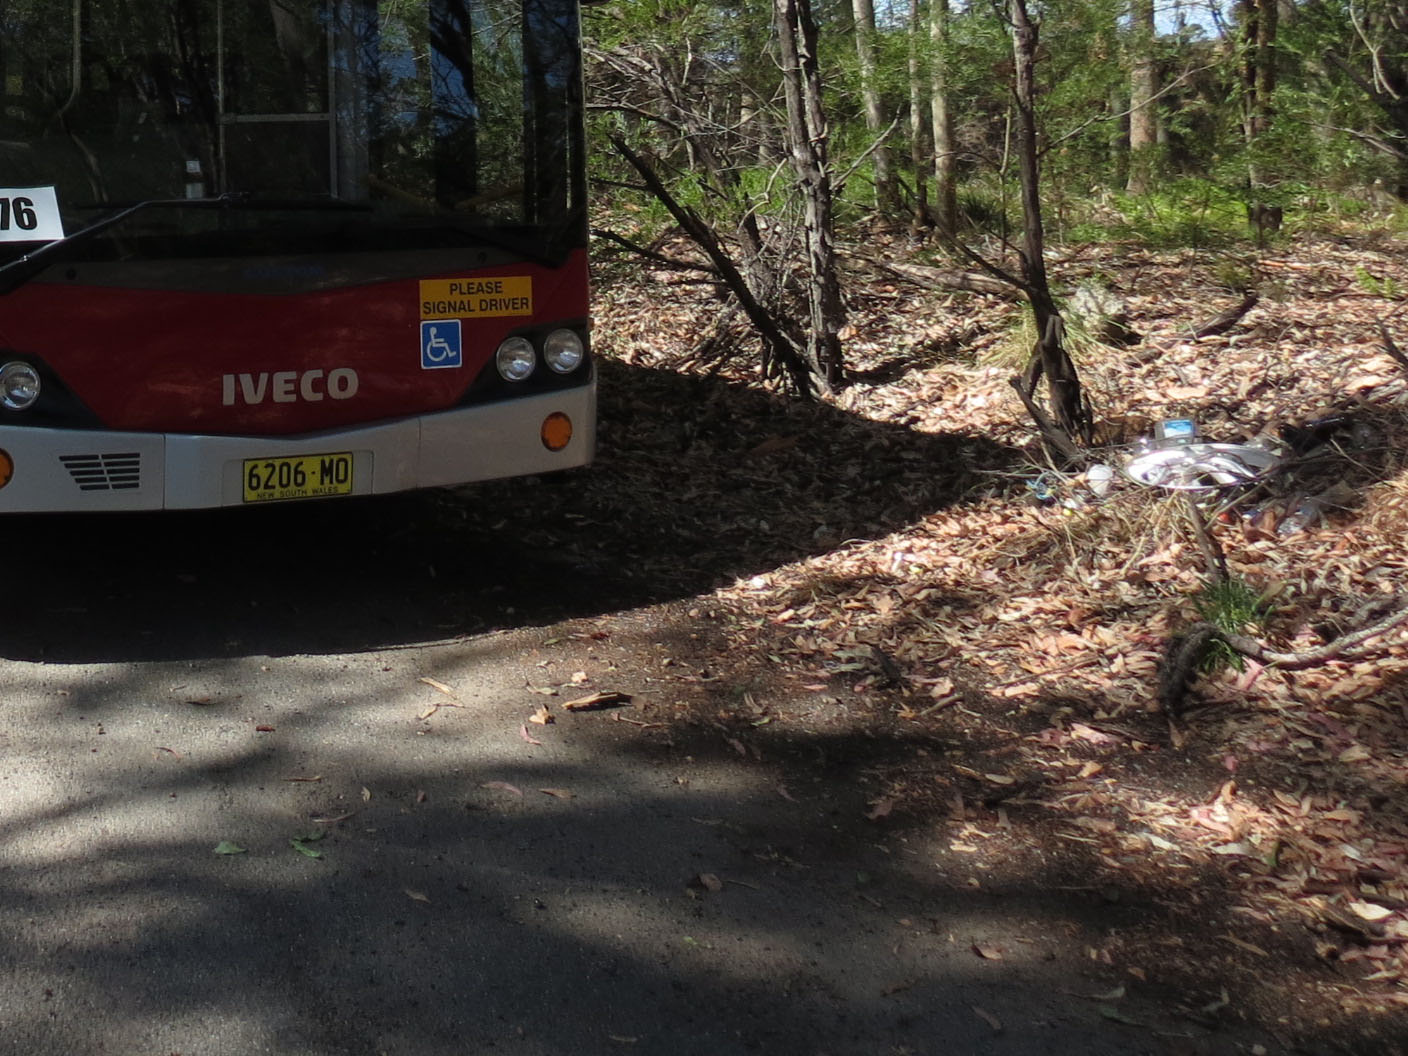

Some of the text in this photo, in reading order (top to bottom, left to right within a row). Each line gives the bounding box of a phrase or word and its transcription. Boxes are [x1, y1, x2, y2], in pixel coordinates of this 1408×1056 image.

[449, 281, 504, 296] PLEASE
[422, 296, 530, 315] SIGNAL DRIVER
[222, 367, 360, 406] IVECO
[257, 486, 338, 500] NEW SOUTH WALES
